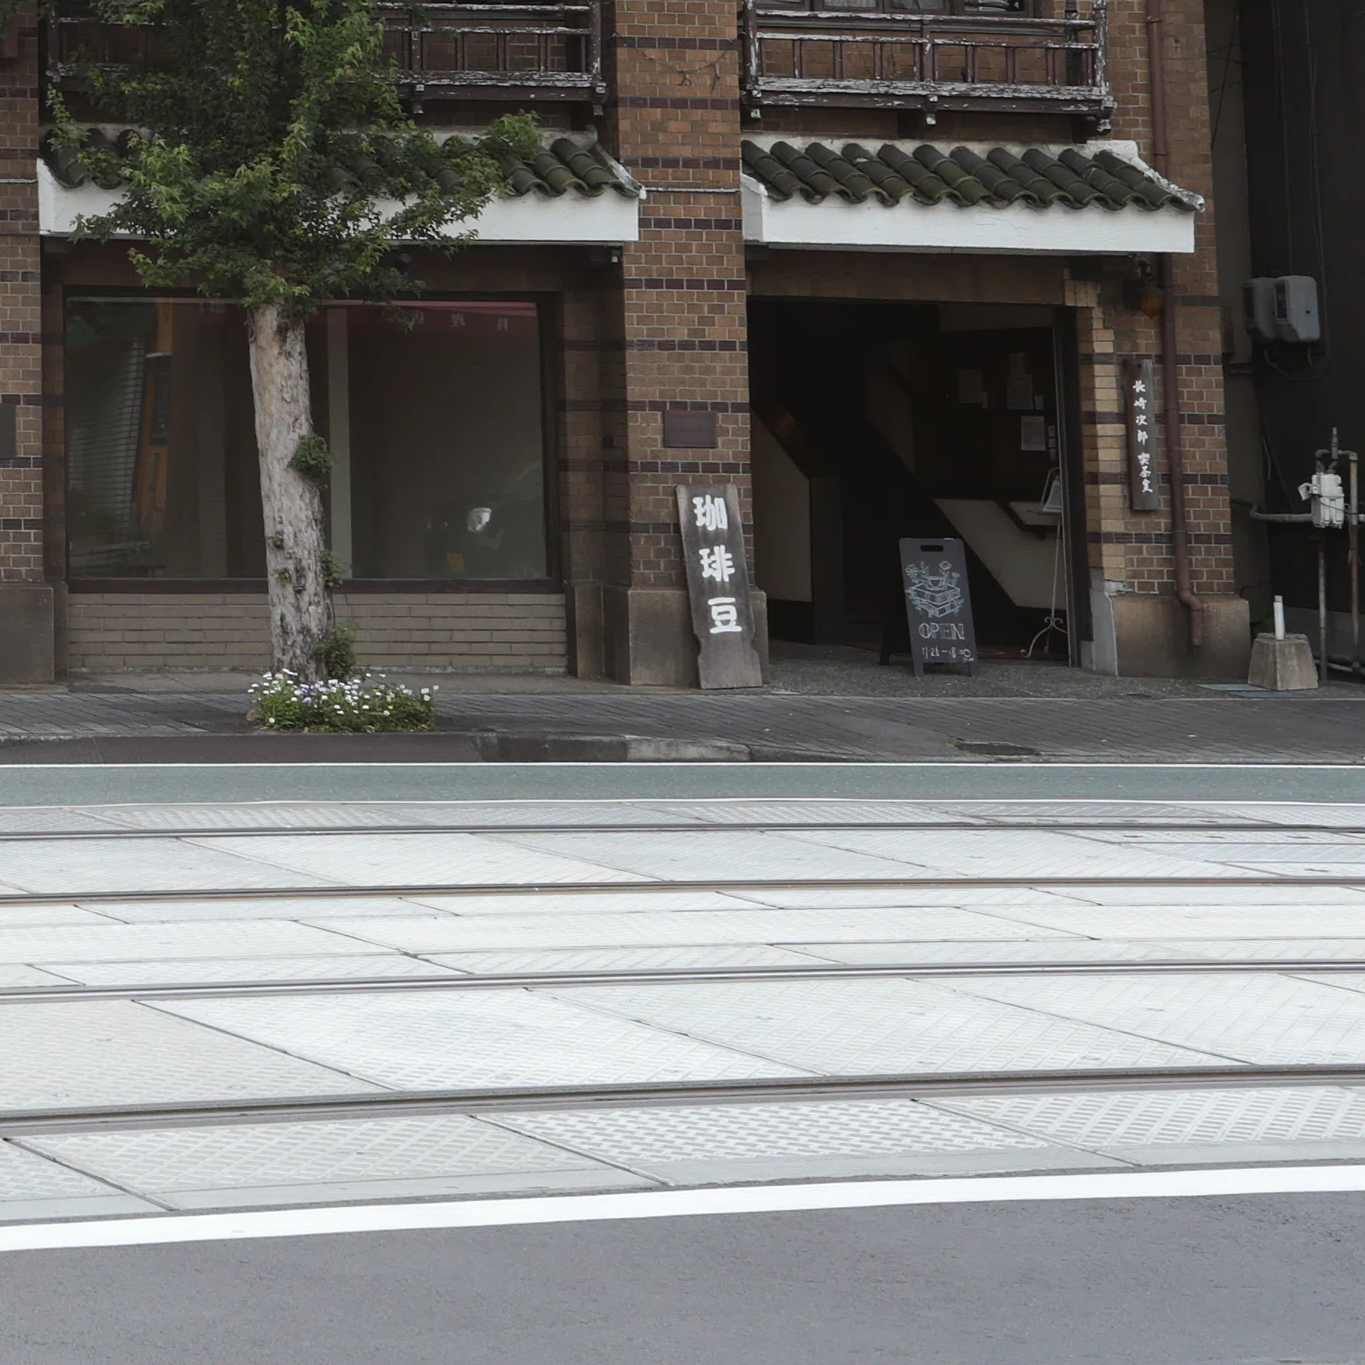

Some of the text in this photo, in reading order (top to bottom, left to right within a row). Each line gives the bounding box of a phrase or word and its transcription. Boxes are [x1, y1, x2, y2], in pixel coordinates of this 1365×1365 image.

[692, 494, 742, 634] 珈琲豆
[918, 622, 966, 640] OPEN
